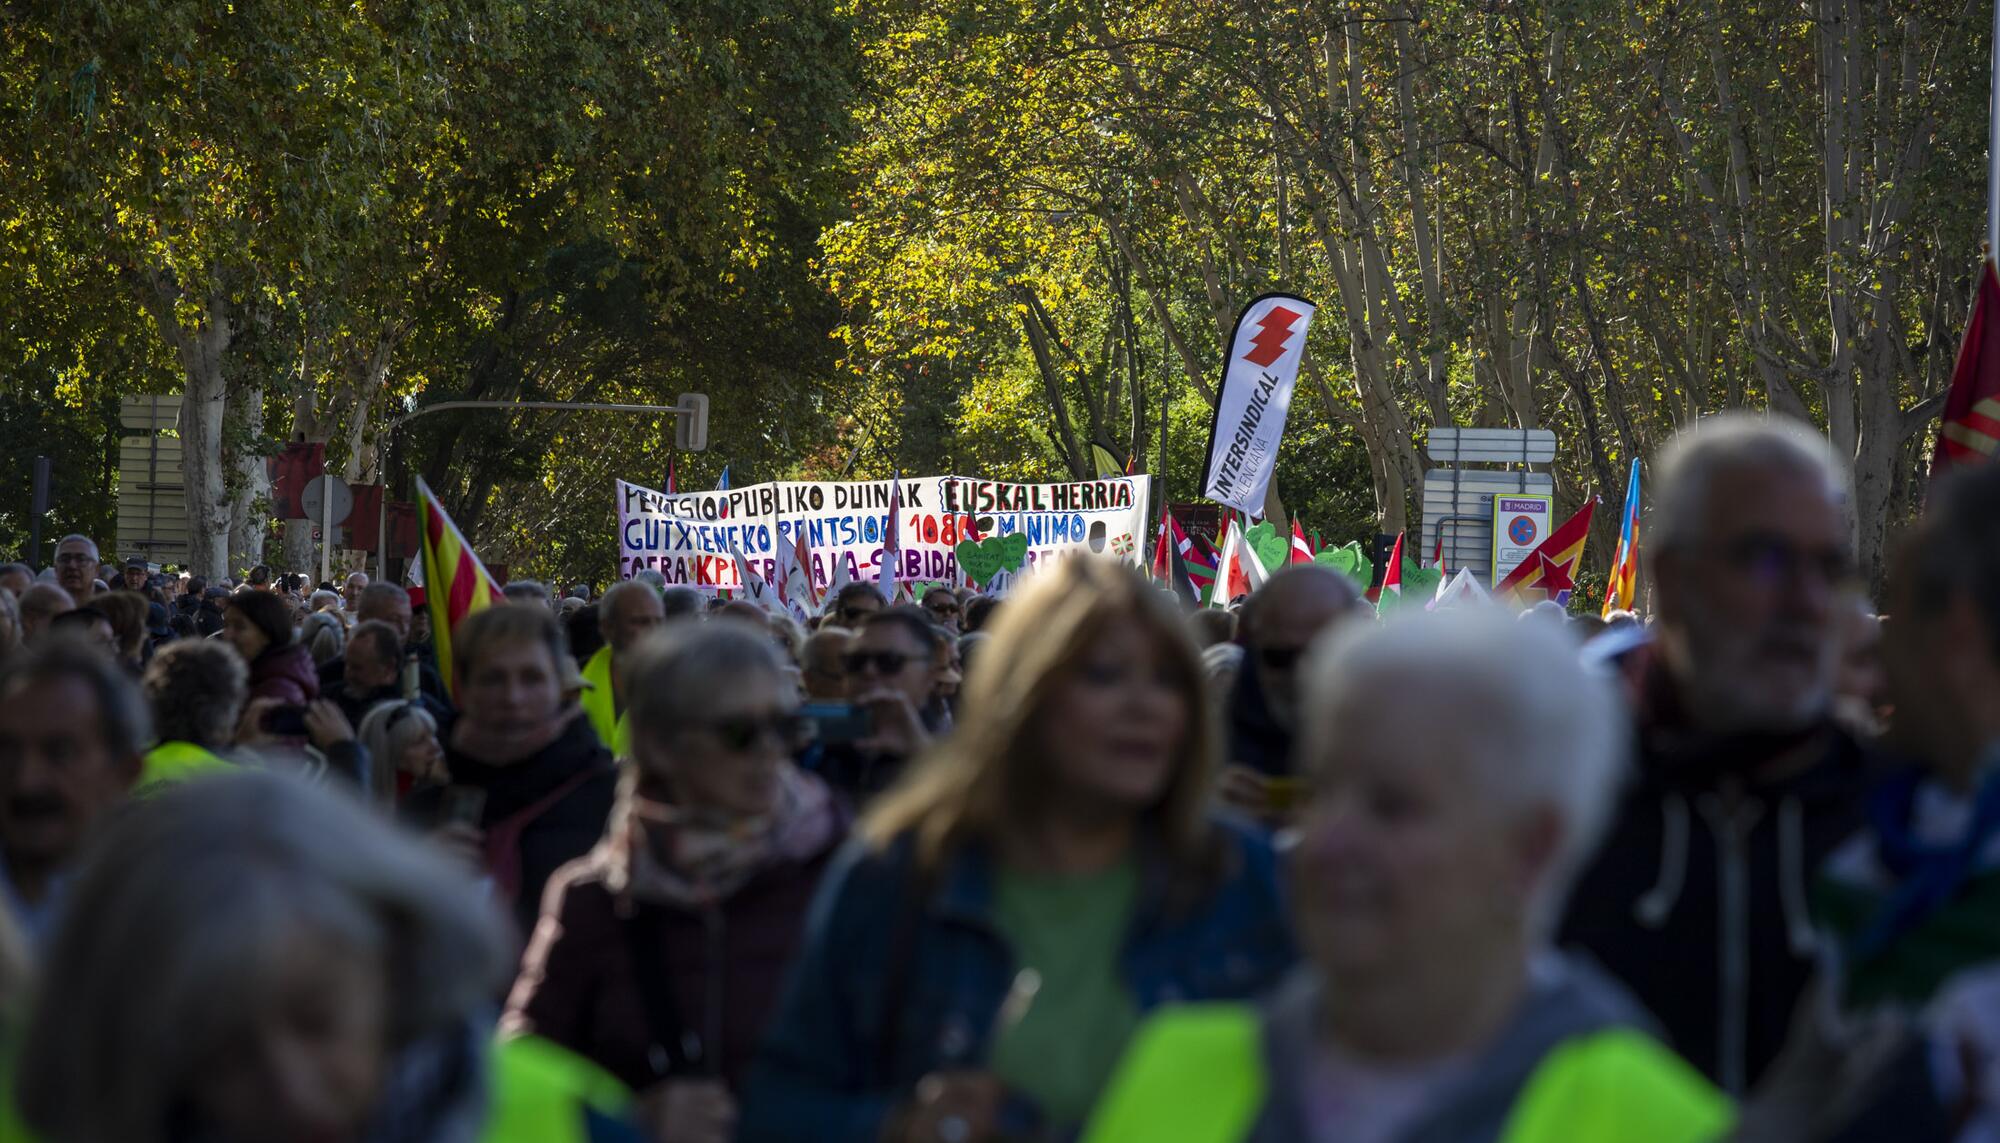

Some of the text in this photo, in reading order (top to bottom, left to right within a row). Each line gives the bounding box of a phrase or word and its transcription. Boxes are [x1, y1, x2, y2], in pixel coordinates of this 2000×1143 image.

[1213, 372, 1280, 499] INTERSINDICAL
[1232, 437, 1268, 506] VALENCIANA
[729, 485, 824, 518] PUBLIKO
[1514, 503, 1542, 511] MADRID
[625, 519, 771, 554] GUTXIENEKO
[998, 514, 1086, 547] MNIMO
